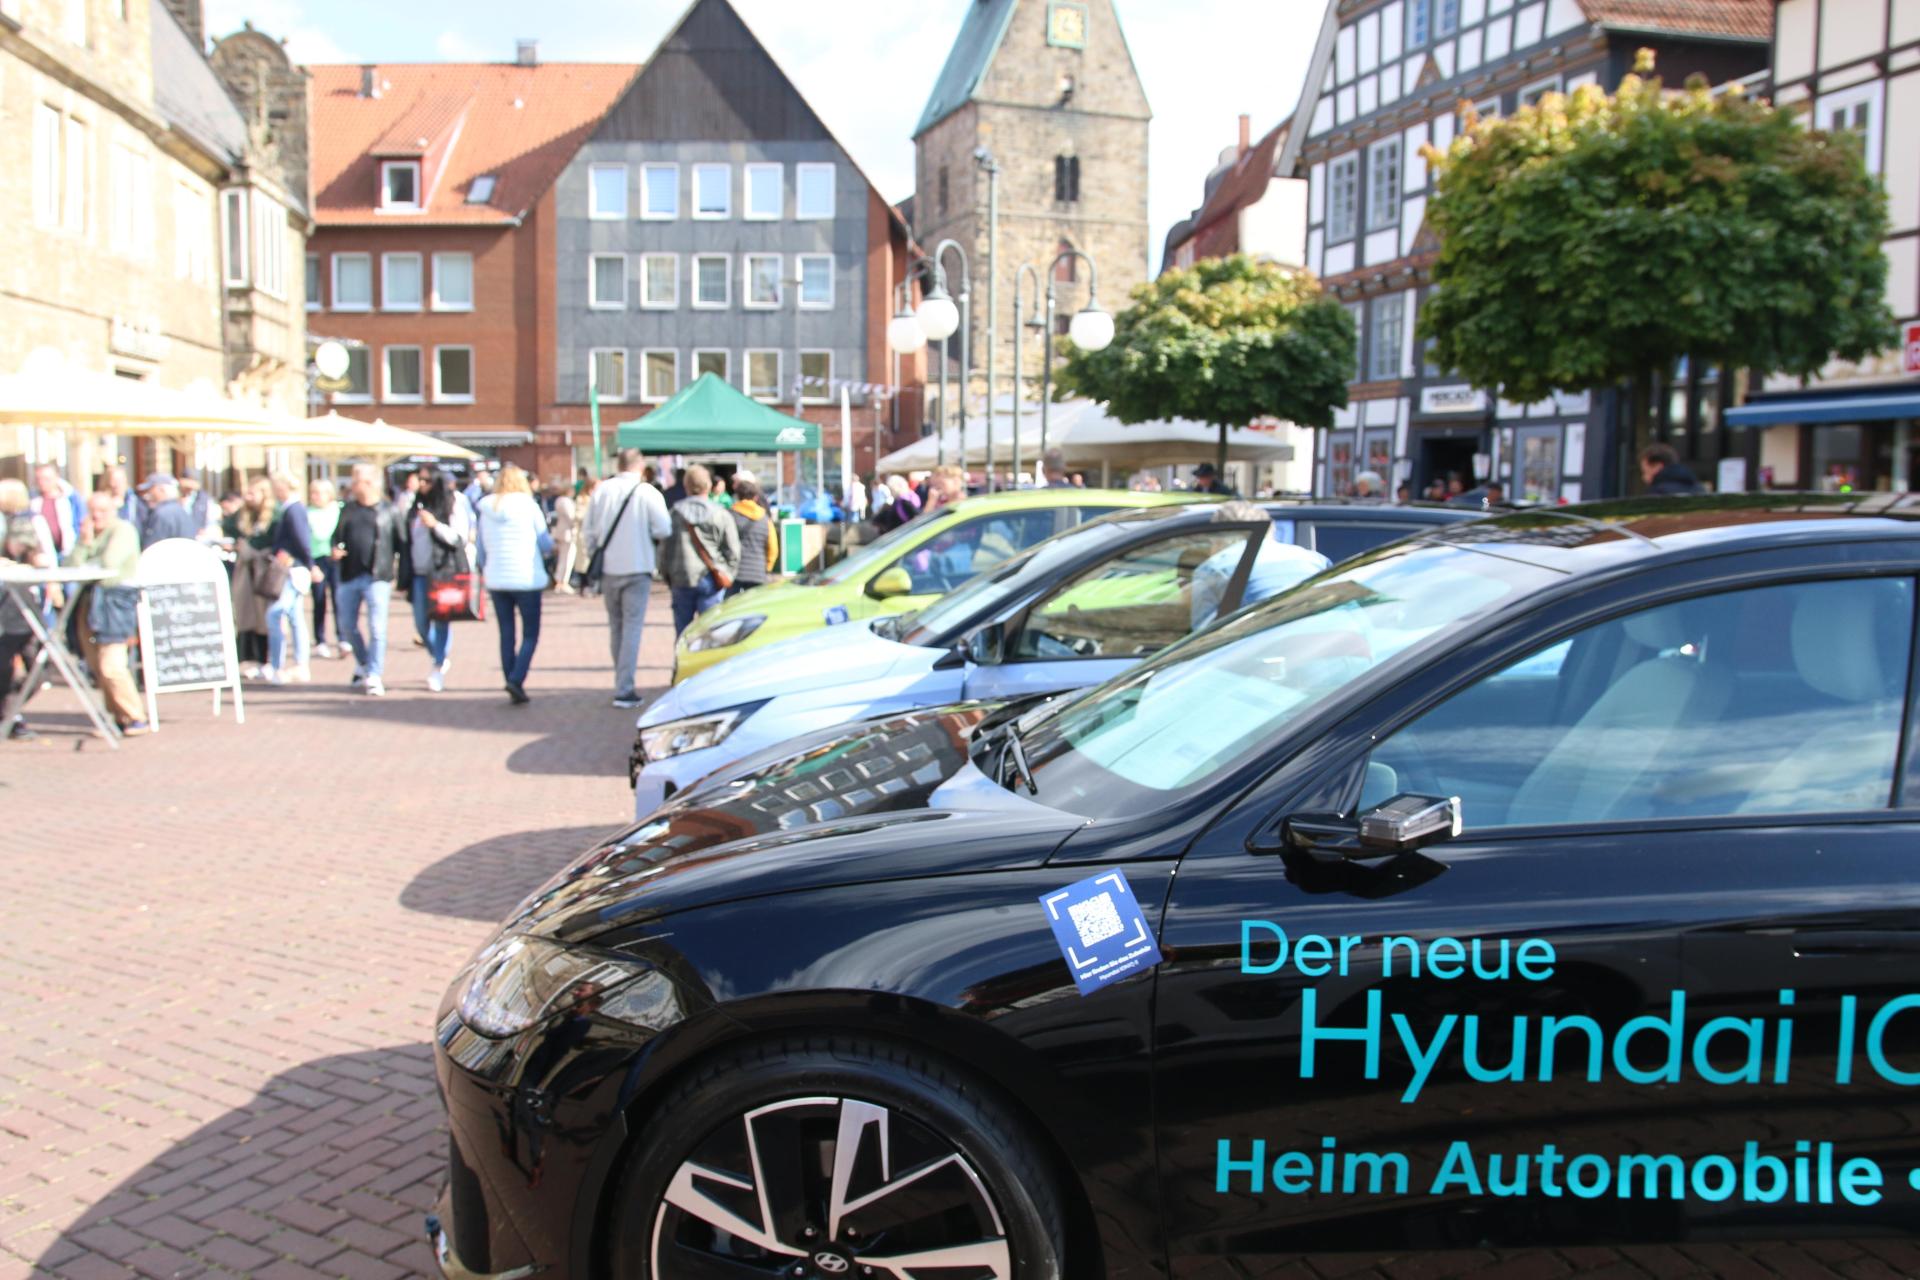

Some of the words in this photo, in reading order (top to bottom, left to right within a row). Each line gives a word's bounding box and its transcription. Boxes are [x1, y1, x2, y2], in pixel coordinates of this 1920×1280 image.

[1239, 918, 1362, 977] Der
[1381, 935, 1557, 981] neue
[1299, 987, 1795, 1103] Hyundai
[1215, 1136, 1409, 1194] Heim
[1430, 1140, 1884, 1207] Automobile
